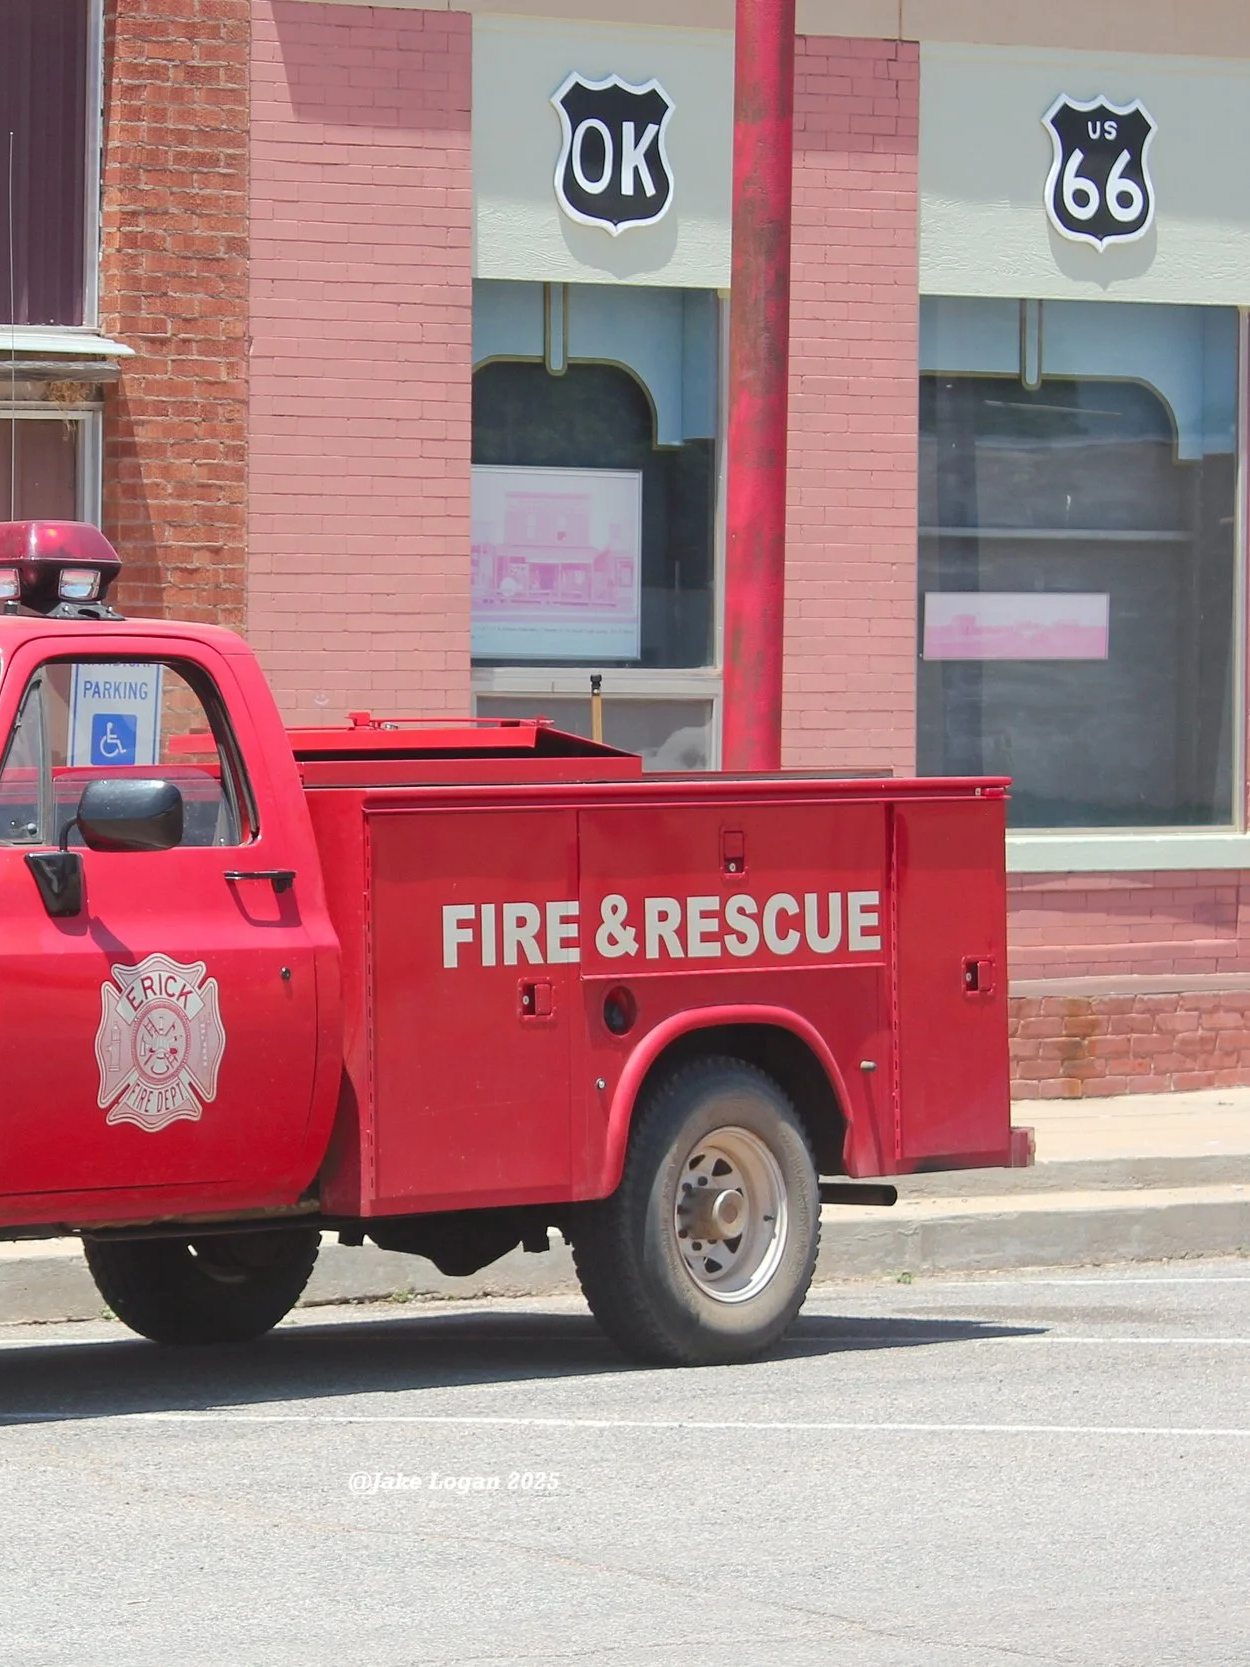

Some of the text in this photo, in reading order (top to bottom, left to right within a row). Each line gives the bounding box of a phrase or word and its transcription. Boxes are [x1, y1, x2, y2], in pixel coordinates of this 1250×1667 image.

[1087, 120, 1118, 141] US
[571, 118, 660, 198] OK
[1062, 147, 1144, 222] 66
[82, 680, 148, 700] PARKING
[442, 901, 580, 968] FIRE
[126, 972, 193, 1011] ERICK
[126, 1082, 154, 1112] FIRE
